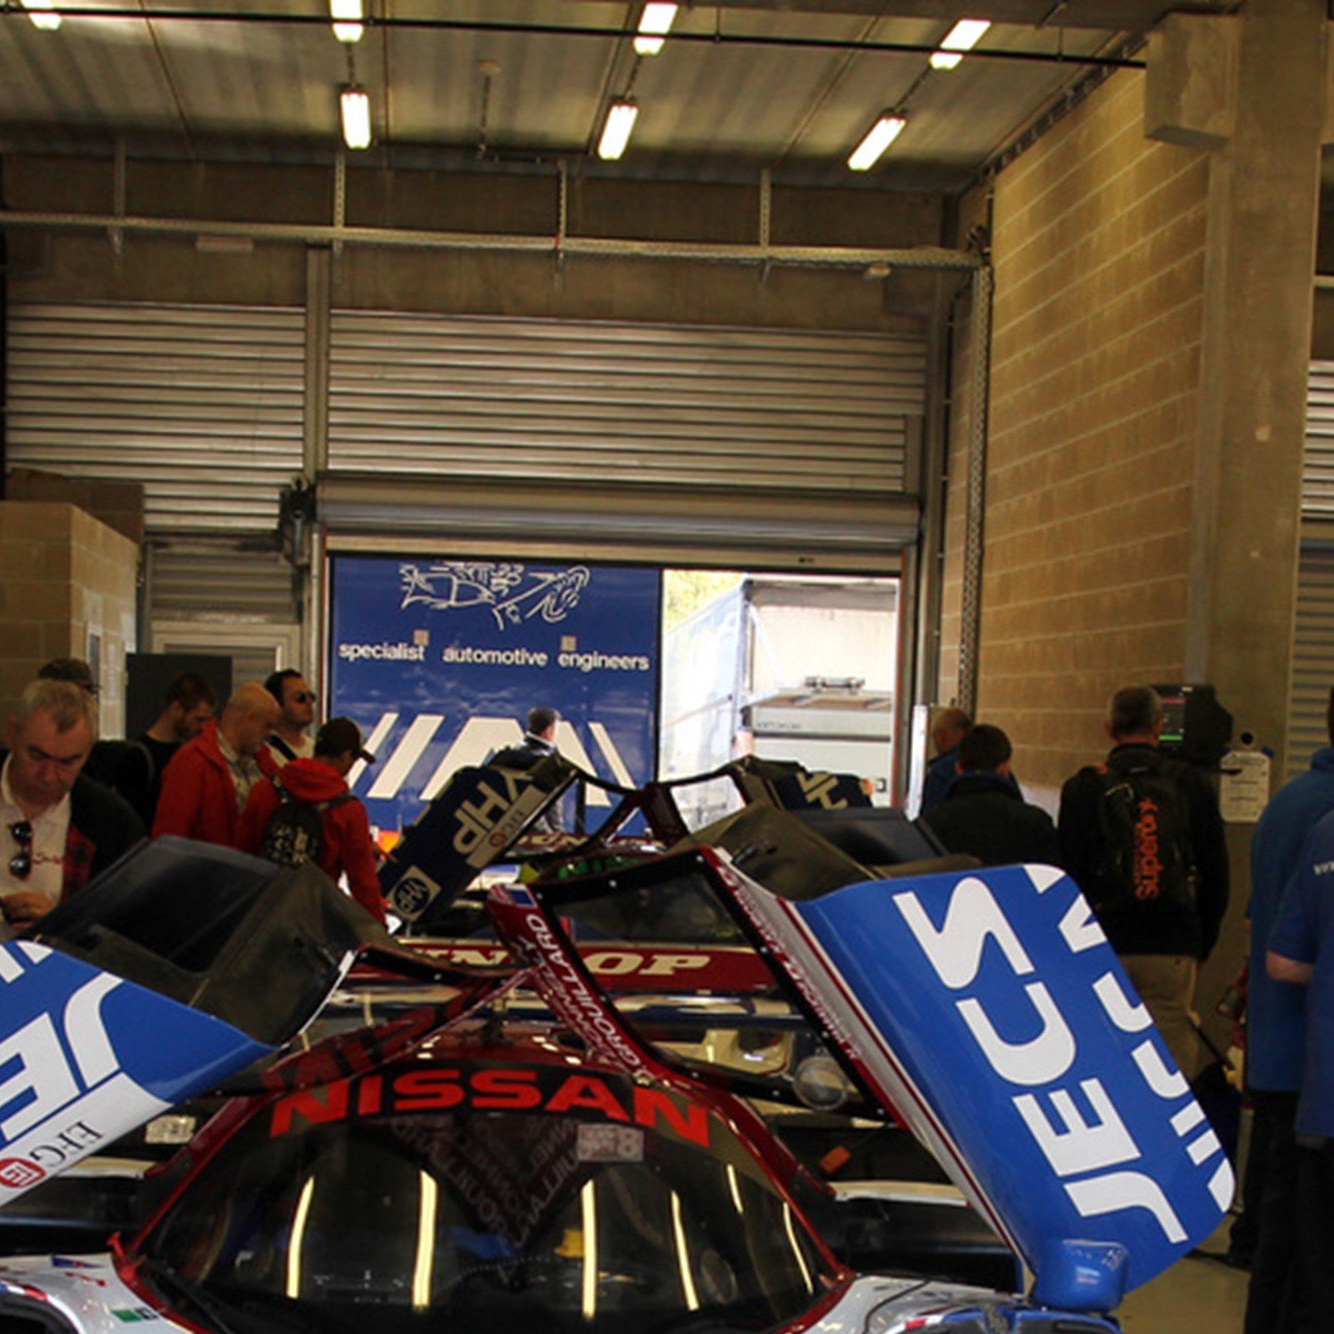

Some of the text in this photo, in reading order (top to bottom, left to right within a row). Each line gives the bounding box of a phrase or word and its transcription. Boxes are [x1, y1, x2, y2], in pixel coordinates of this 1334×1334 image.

[338, 642, 650, 672] specialist automotive engineers
[892, 876, 1189, 1245] JECS
[269, 1067, 710, 1149] NISSAN
[28, 1120, 104, 1168] EFG
